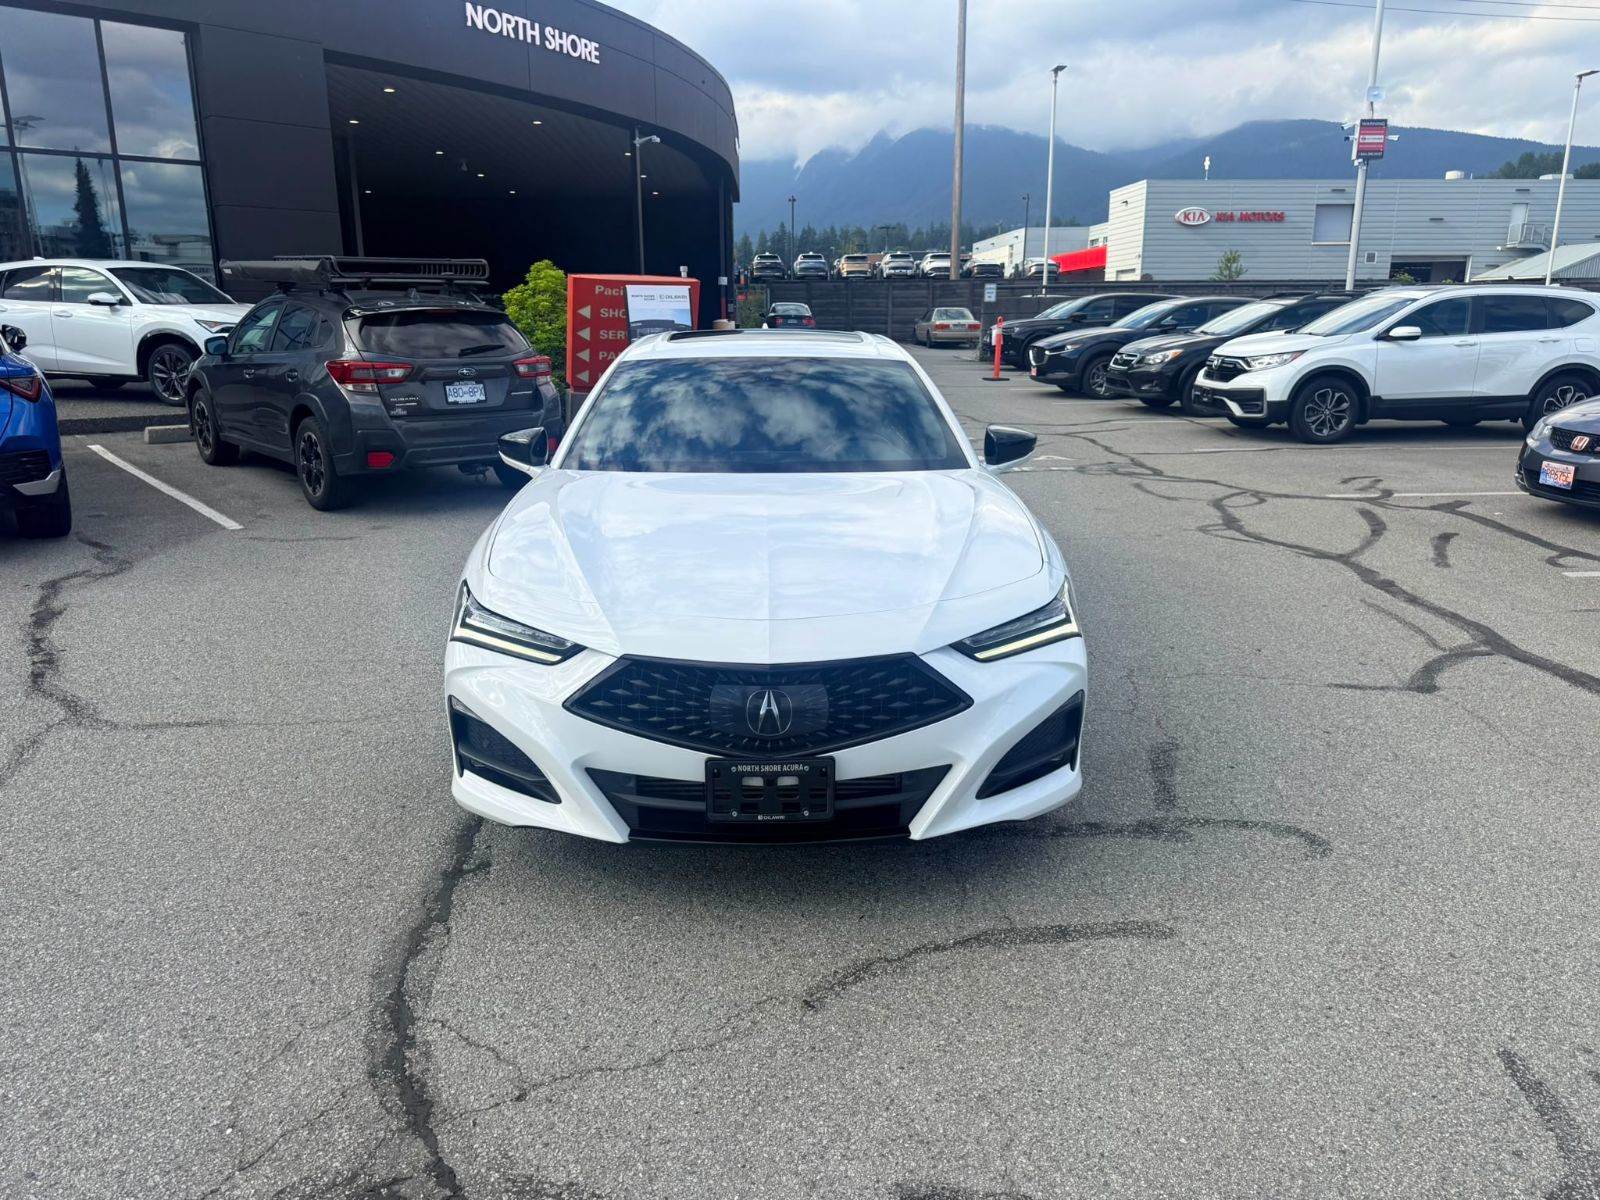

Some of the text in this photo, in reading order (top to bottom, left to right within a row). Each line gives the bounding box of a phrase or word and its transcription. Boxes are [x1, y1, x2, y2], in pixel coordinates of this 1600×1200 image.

[465, 2, 600, 64] NORTH SHORE
[1183, 211, 1206, 222] KIA
[1215, 211, 1286, 223] KIA MOTORS
[599, 329, 627, 340] SER
[599, 351, 620, 361] PA
[738, 763, 804, 772] NORTH SHORE ACURA
